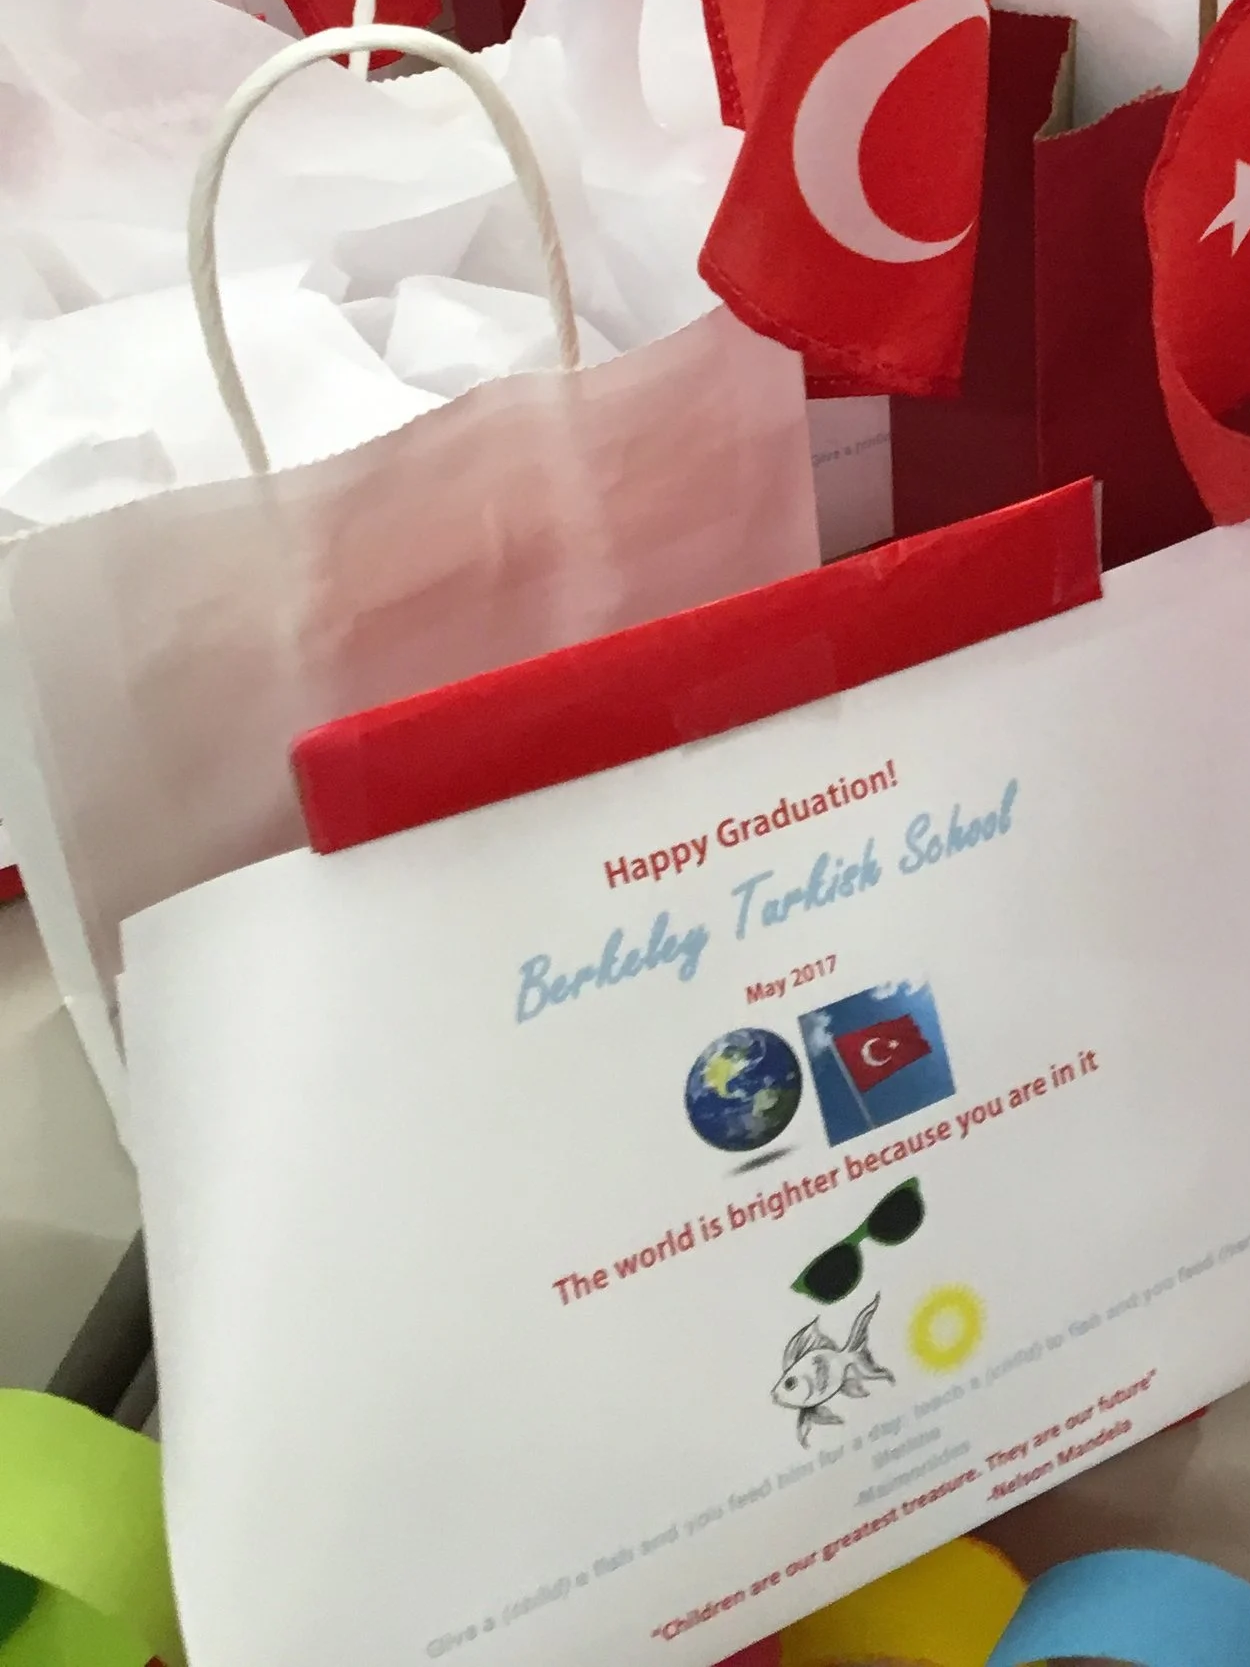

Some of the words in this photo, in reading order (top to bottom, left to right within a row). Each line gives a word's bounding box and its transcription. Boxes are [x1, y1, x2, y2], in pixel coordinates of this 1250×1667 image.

[516, 911, 710, 1024] Berkeley
[731, 838, 882, 941] Turkish
[900, 778, 1018, 875] School
[604, 835, 708, 888] Happy
[716, 759, 898, 848] Graduation!
[745, 977, 787, 1005] May
[792, 954, 838, 987] 2017
[551, 1268, 610, 1306] The
[613, 1221, 696, 1280] world
[699, 1215, 723, 1242] is
[727, 1167, 840, 1230] brighter
[844, 1120, 951, 1181] because
[956, 1096, 1004, 1139] you
[1008, 1076, 1047, 1109] are
[1050, 1063, 1075, 1088] in
[1078, 1049, 1099, 1074] it
[750, 1570, 781, 1597] are
[785, 1551, 818, 1578] our
[821, 1507, 900, 1563] greatest
[901, 1467, 983, 1517] treasure.
[985, 1440, 1029, 1472] They
[1032, 1424, 1061, 1449] are
[1064, 1406, 1095, 1430] our
[1057, 1418, 1133, 1466] Mandela
